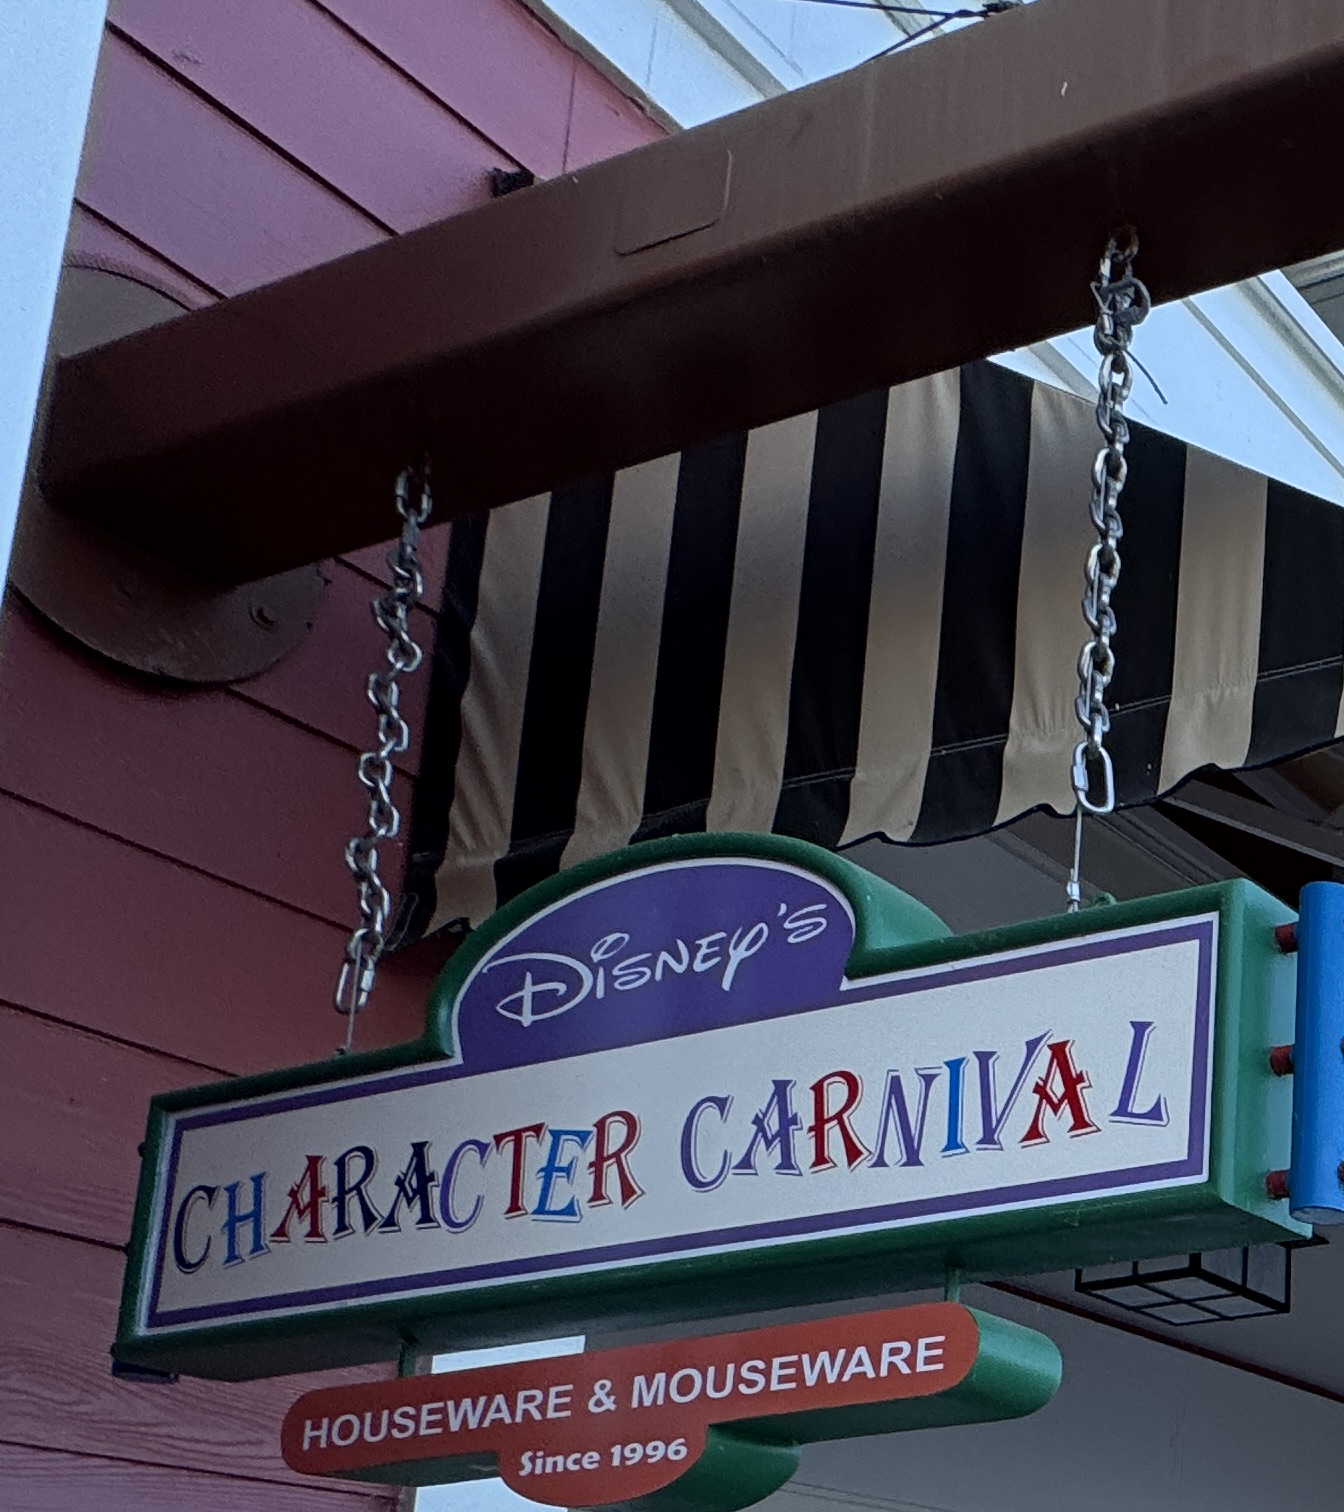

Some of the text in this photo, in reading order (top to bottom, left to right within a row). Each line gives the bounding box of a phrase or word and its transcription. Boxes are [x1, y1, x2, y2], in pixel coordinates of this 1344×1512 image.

[172, 1019, 1170, 1274] CHARACTER CARNIVAL
[302, 1335, 947, 1450] HOUSEWARE & MOUSEWARE
[518, 1438, 688, 1477] Since 1996
